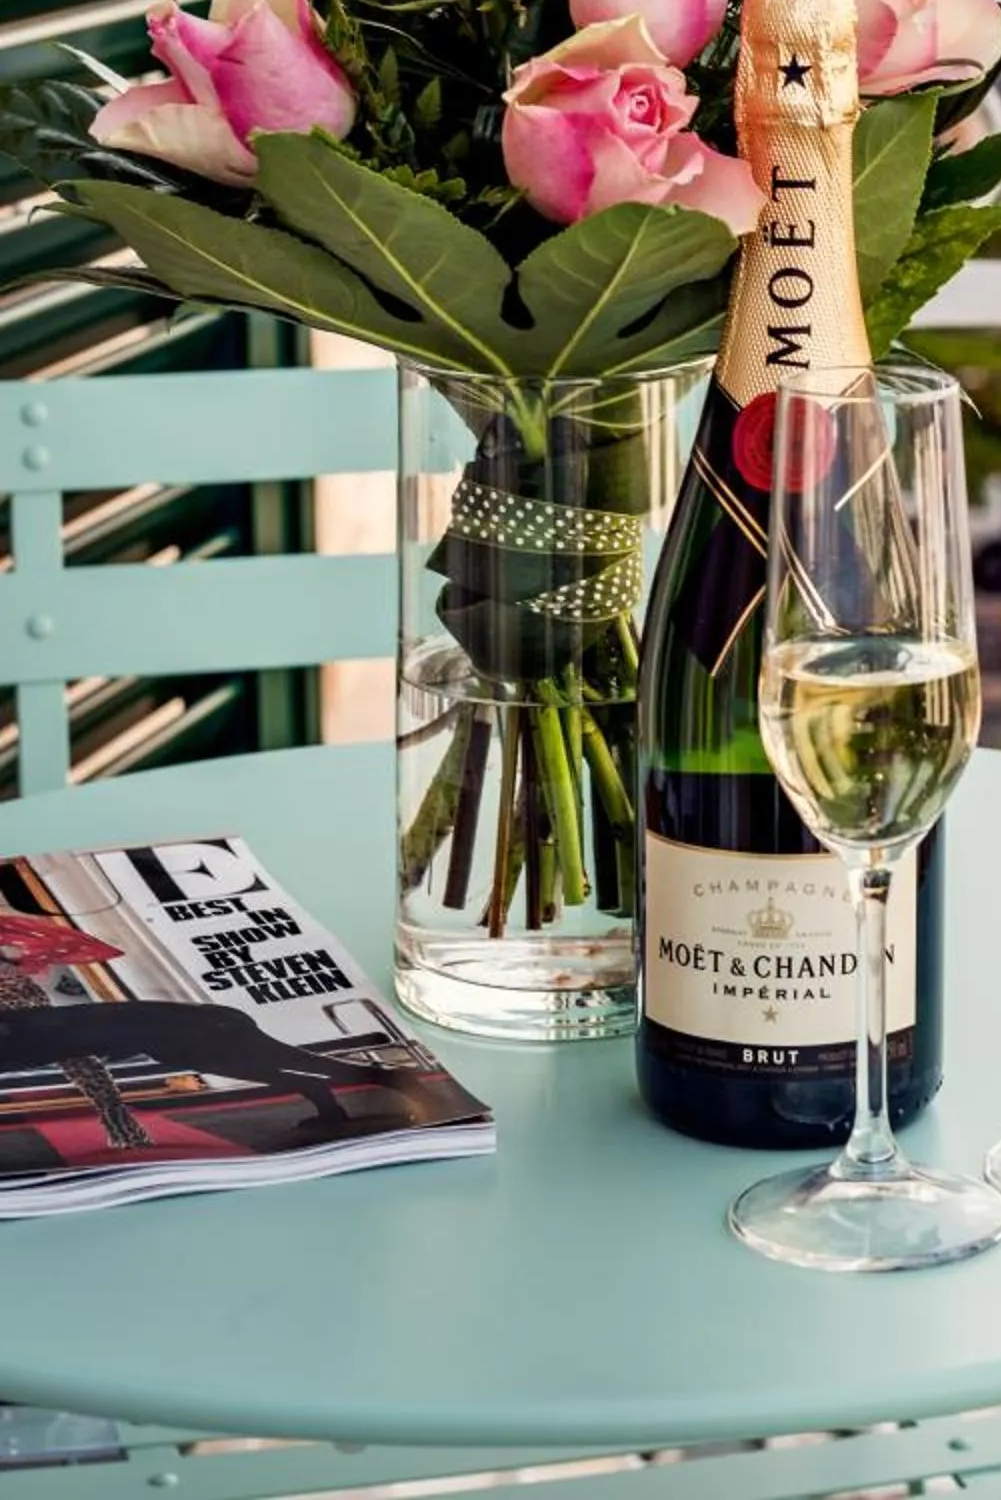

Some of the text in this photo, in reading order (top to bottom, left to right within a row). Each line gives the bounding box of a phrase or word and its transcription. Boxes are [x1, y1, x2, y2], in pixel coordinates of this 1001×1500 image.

[763, 165, 817, 369] MOËT
[162, 897, 249, 923] BEST
[246, 907, 294, 925] IN
[191, 921, 303, 952] SHOW
[201, 949, 338, 990] STEVEN
[203, 945, 255, 969] BY
[658, 936, 895, 979] MOËT & CHANDN
[246, 969, 354, 1005] KLEIN
[713, 983, 832, 1000] IMPÉRIAL
[742, 1048, 800, 1065] BRUT
